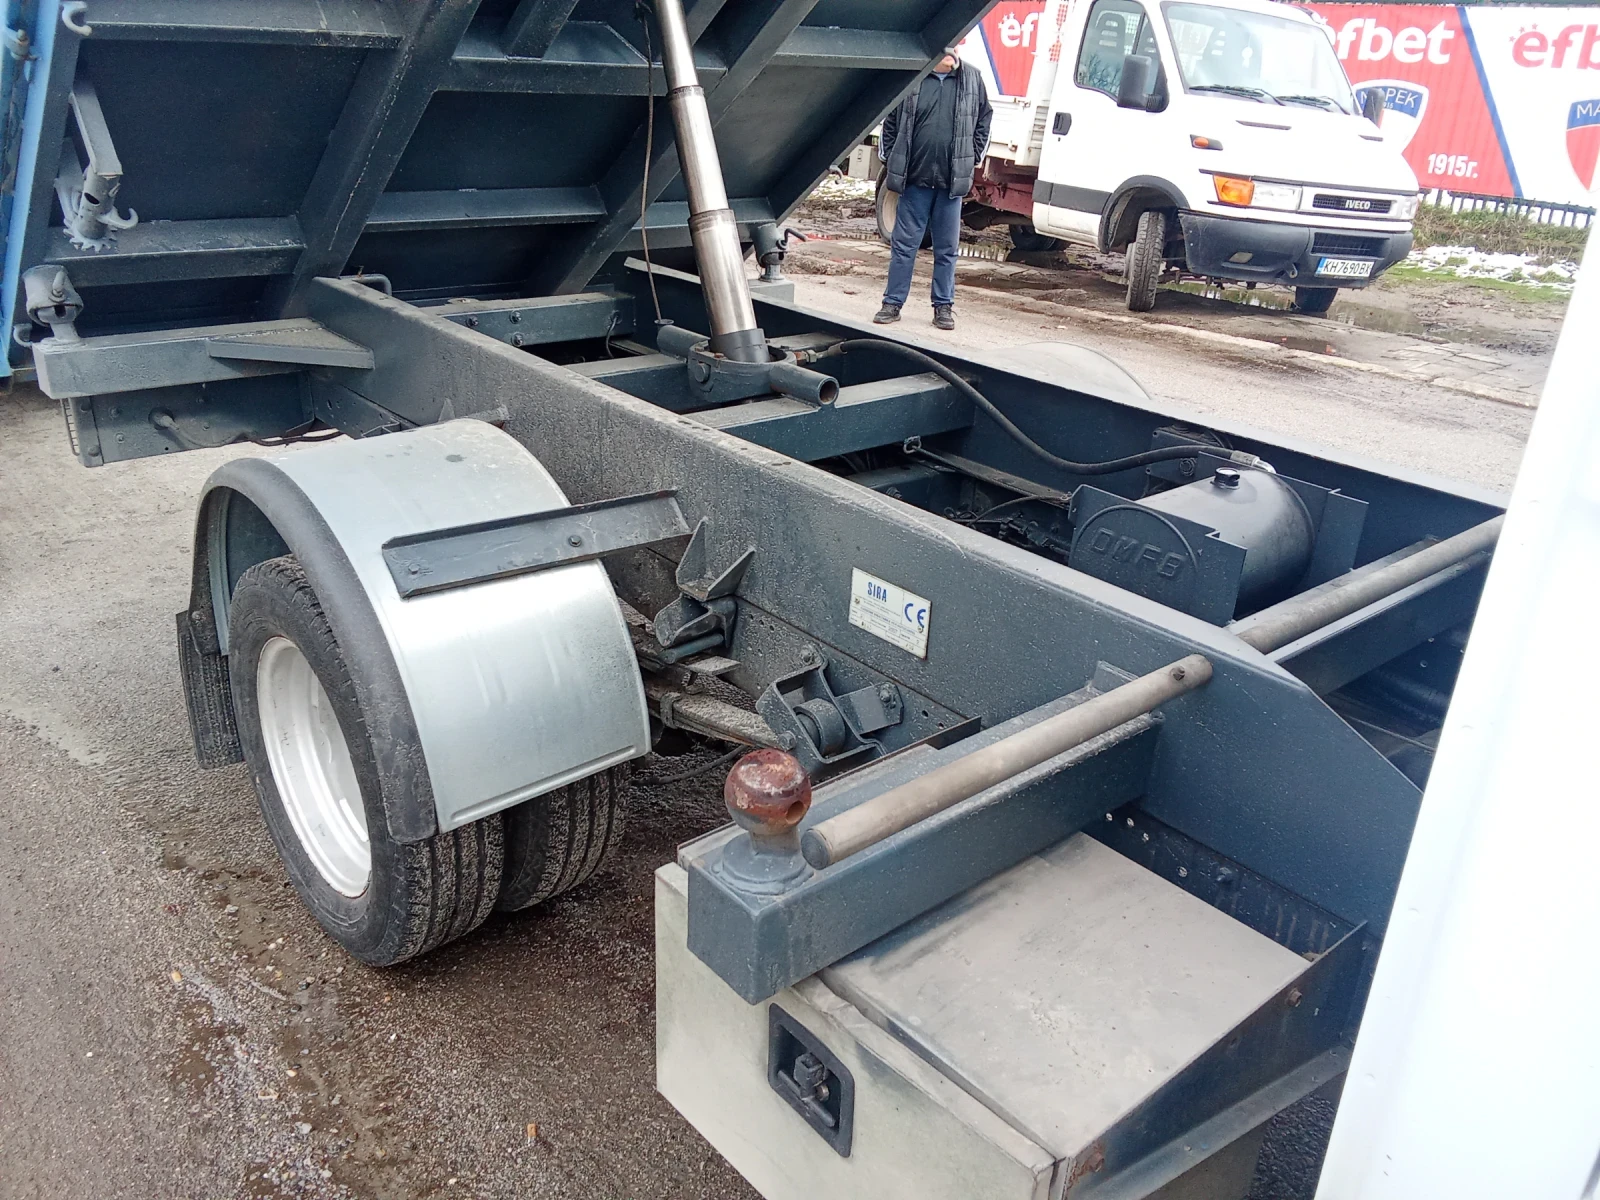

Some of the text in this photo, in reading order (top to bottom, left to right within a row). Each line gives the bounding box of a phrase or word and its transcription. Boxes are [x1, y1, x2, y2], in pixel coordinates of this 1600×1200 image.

[1000, 12, 1044, 48] ef
[1345, 199, 1371, 210] IVECO
[1090, 527, 1187, 578] OMFB
[867, 581, 888, 603] SIRA
[904, 602, 927, 629] CE
